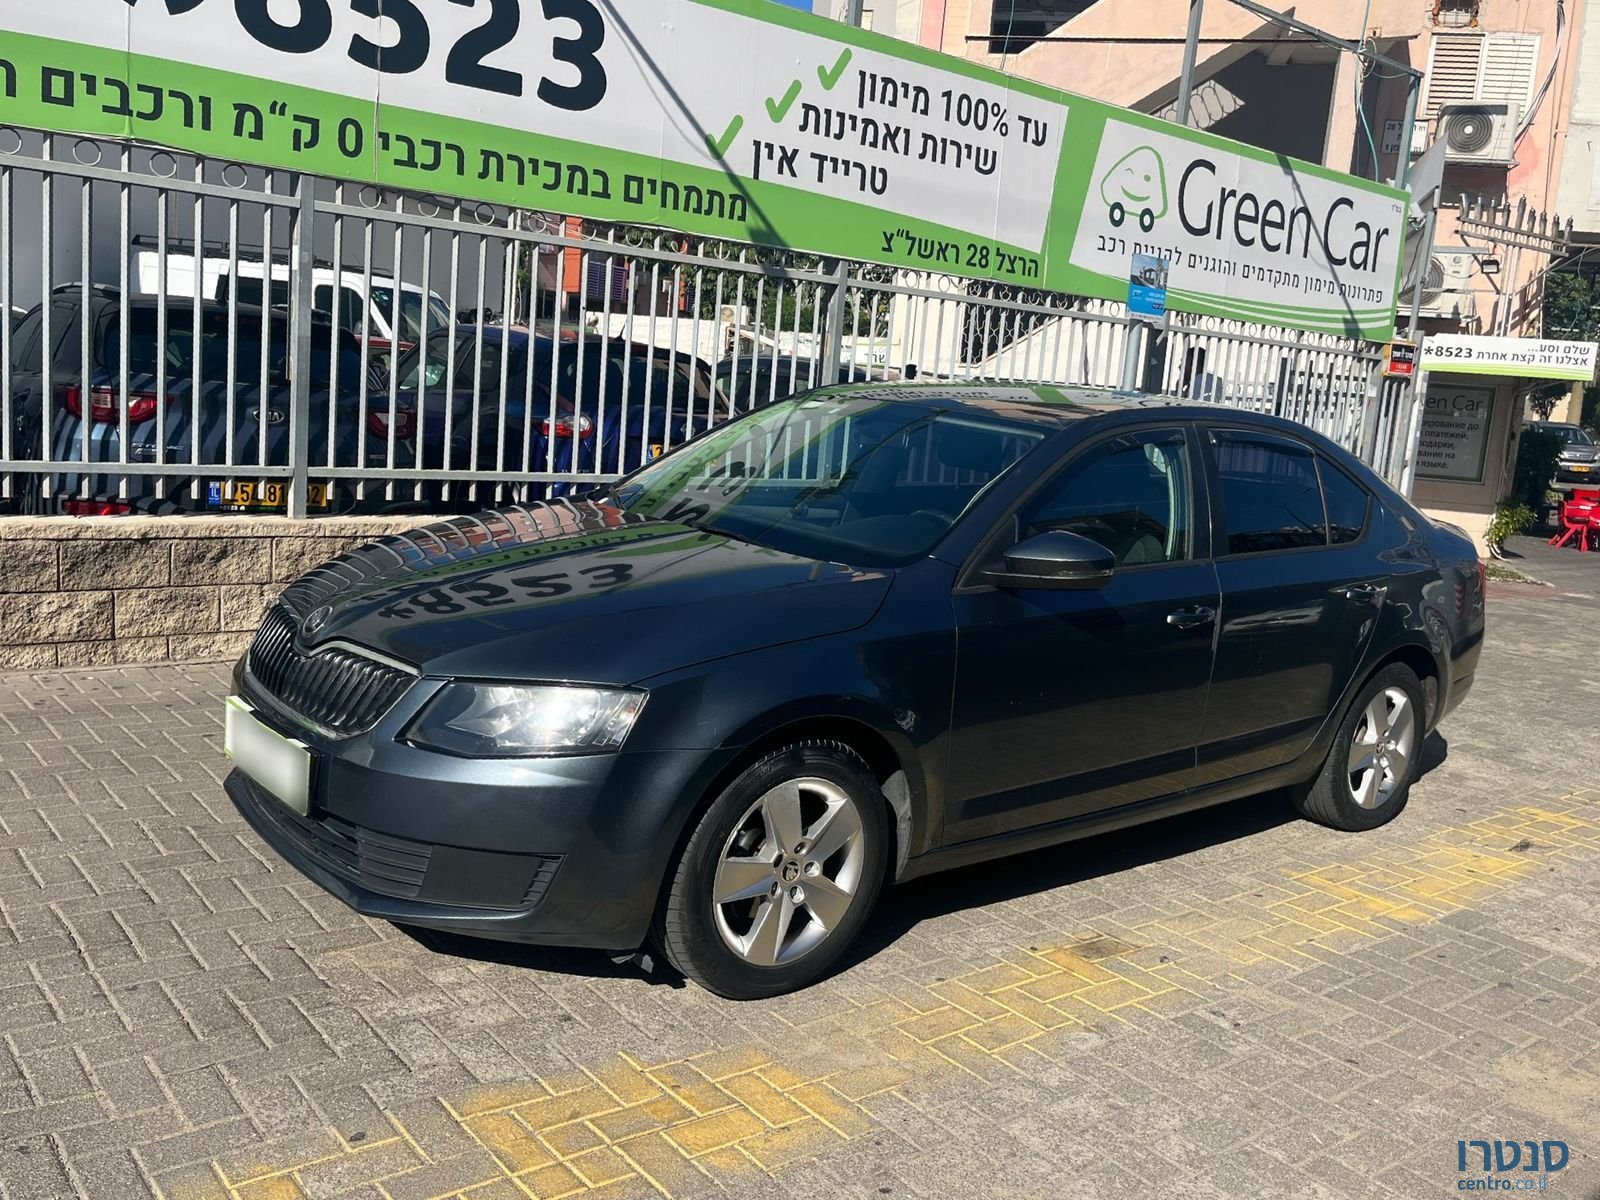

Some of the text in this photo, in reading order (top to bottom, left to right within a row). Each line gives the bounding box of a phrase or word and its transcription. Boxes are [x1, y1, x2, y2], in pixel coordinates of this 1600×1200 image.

[41, 65, 212, 131] ורכבים
[858, 70, 1048, 147] עד 100% מימון
[338, 117, 363, 158] 0
[799, 102, 997, 176] שירות ואמינות
[378, 131, 465, 176] רכבי
[477, 148, 611, 200] במכירת
[752, 139, 888, 195] טרייד אין
[623, 174, 748, 222] מתמחים
[1178, 158, 1389, 273] Green Car
[965, 243, 990, 269] 28
[1097, 235, 1126, 255] רכב
[996, 247, 1039, 278] הרצל
[1188, 253, 1237, 277] והוגנים
[1242, 263, 1300, 289] מתקדמים
[1304, 276, 1335, 295] מימון
[1339, 283, 1383, 304] פתרונות
[1476, 350, 1507, 362] אחרת
[1511, 352, 1535, 365] קצת
[1539, 353, 1552, 364] זה
[1556, 354, 1588, 366] אצלנו
[1563, 343, 1590, 355] שלם
[1452, 394, 1484, 412] Car
